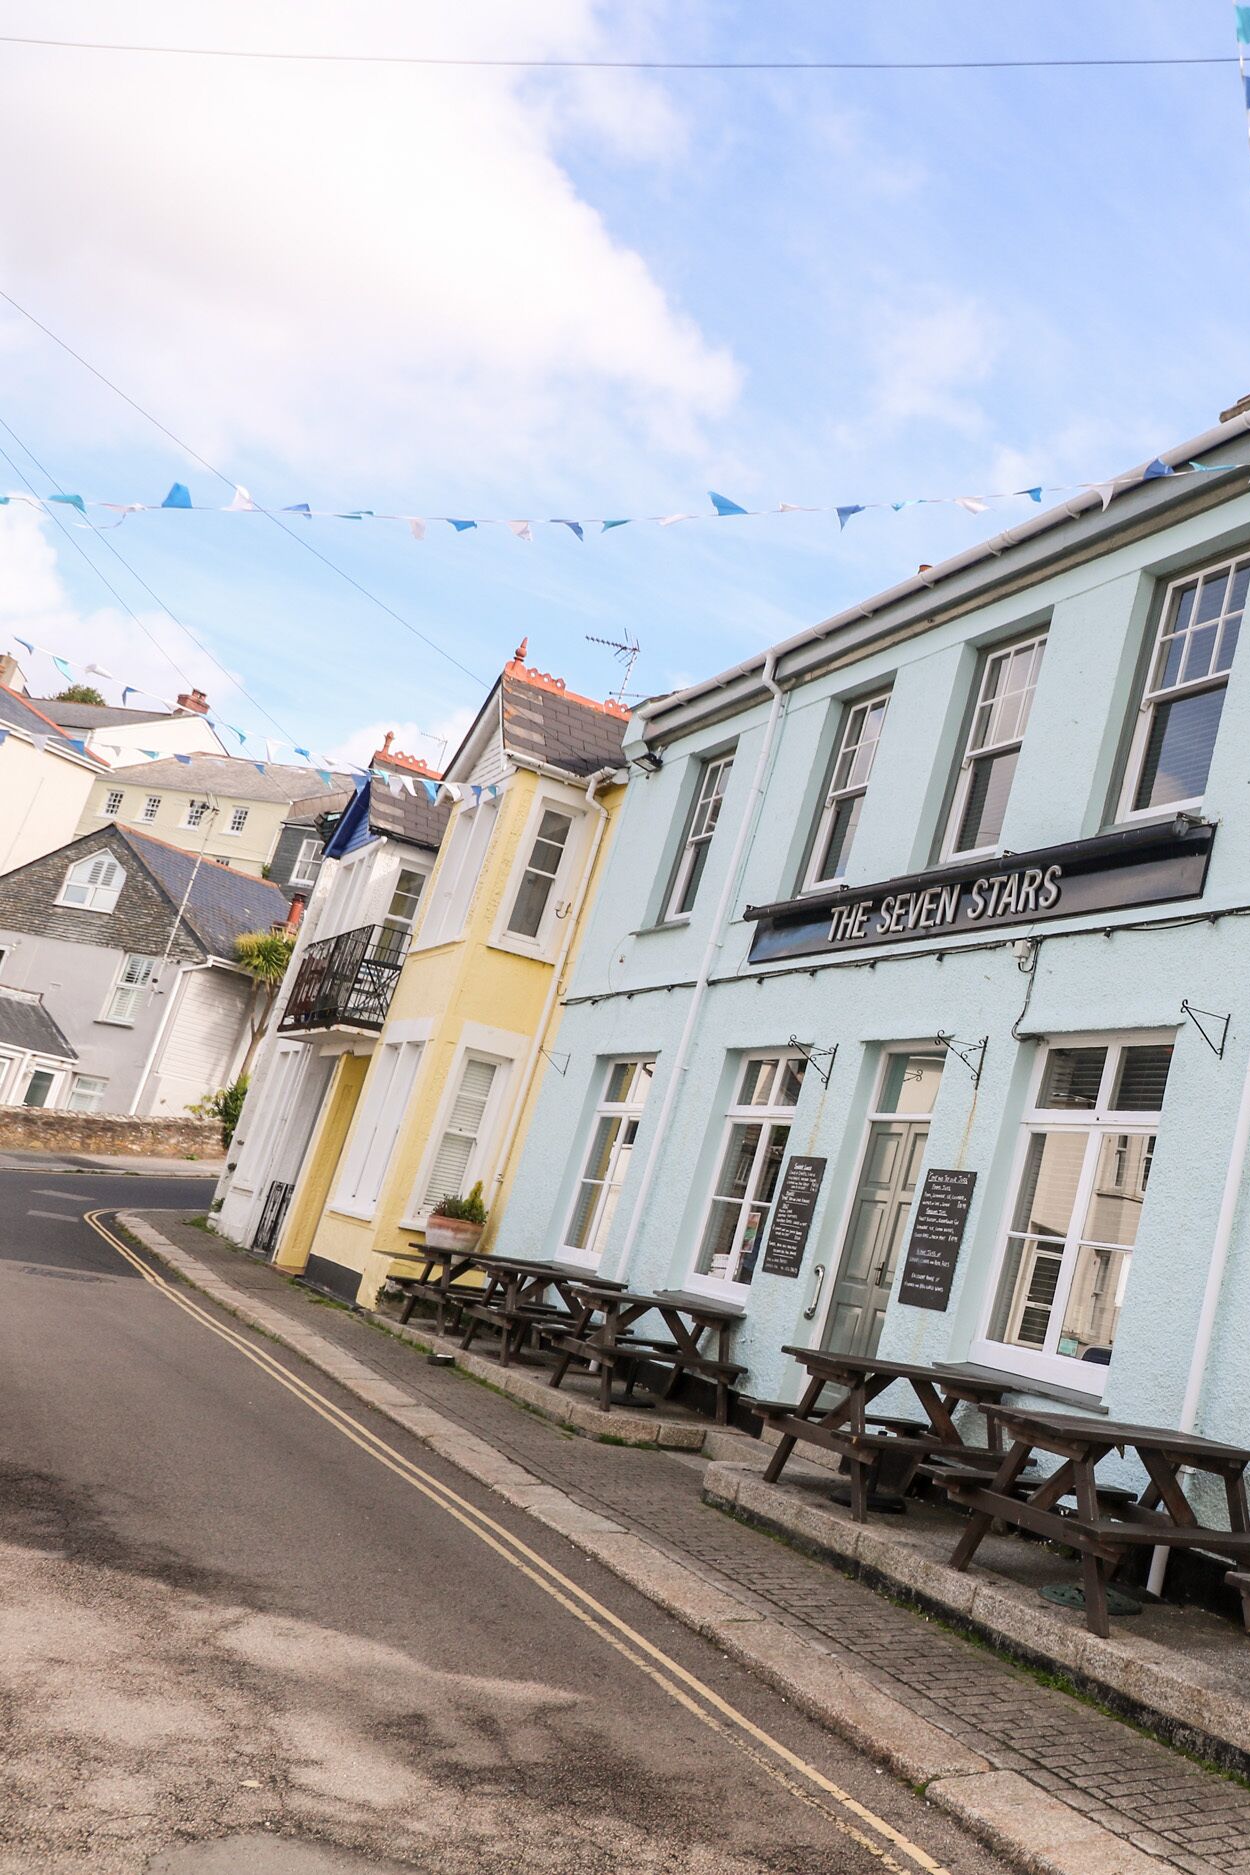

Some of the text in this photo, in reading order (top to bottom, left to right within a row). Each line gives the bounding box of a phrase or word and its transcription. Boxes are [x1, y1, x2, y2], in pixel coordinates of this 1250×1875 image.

[828, 865, 1062, 942] THE SEVEN STARS
